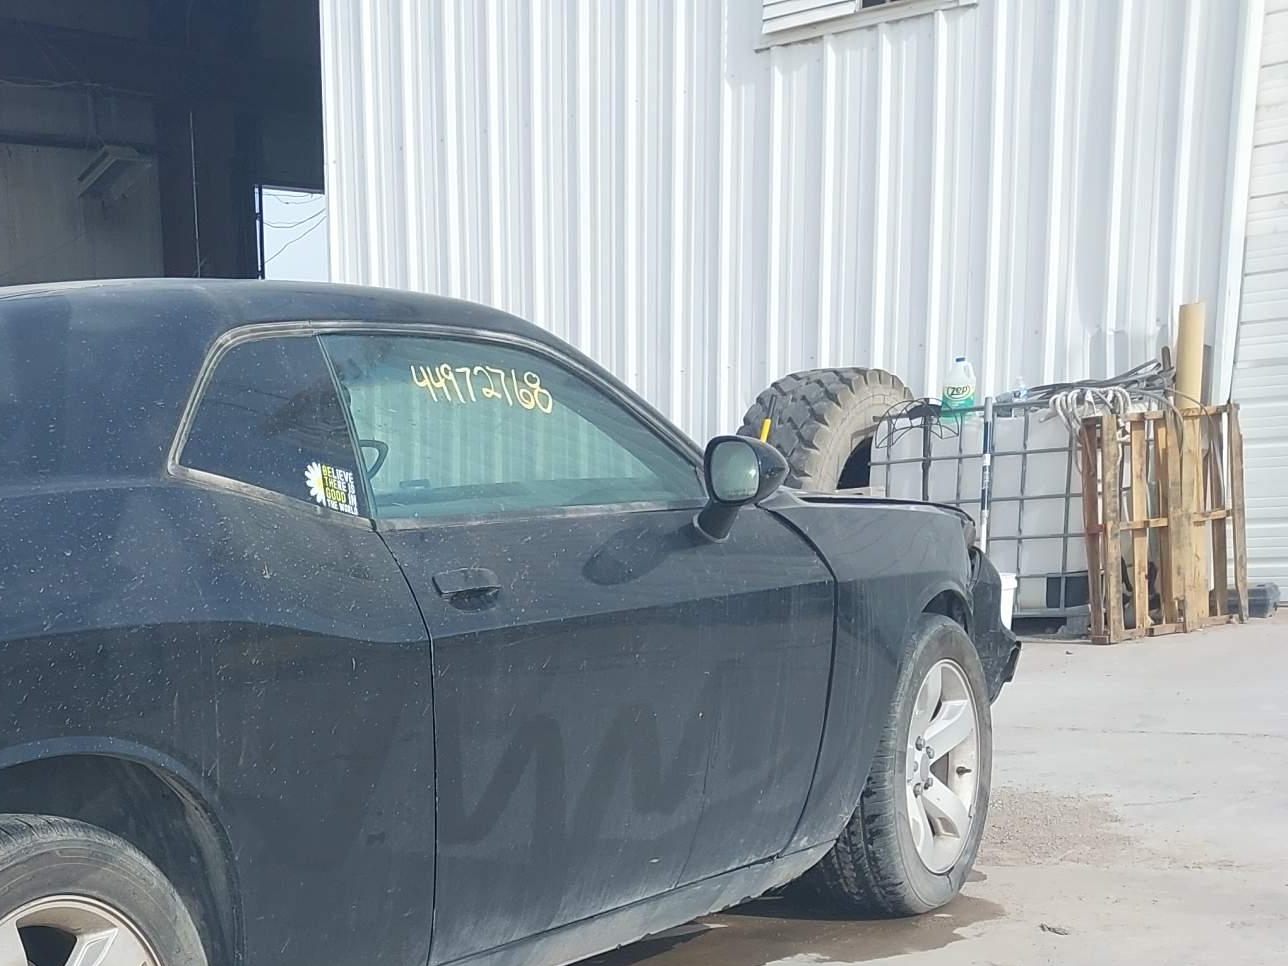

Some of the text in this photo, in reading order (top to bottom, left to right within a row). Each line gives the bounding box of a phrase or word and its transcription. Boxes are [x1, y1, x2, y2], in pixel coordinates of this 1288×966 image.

[410, 363, 553, 414] 44972768
[322, 465, 354, 483] BELIEVE
[323, 476, 356, 494] THERE IS
[325, 488, 347, 503] GOOD
